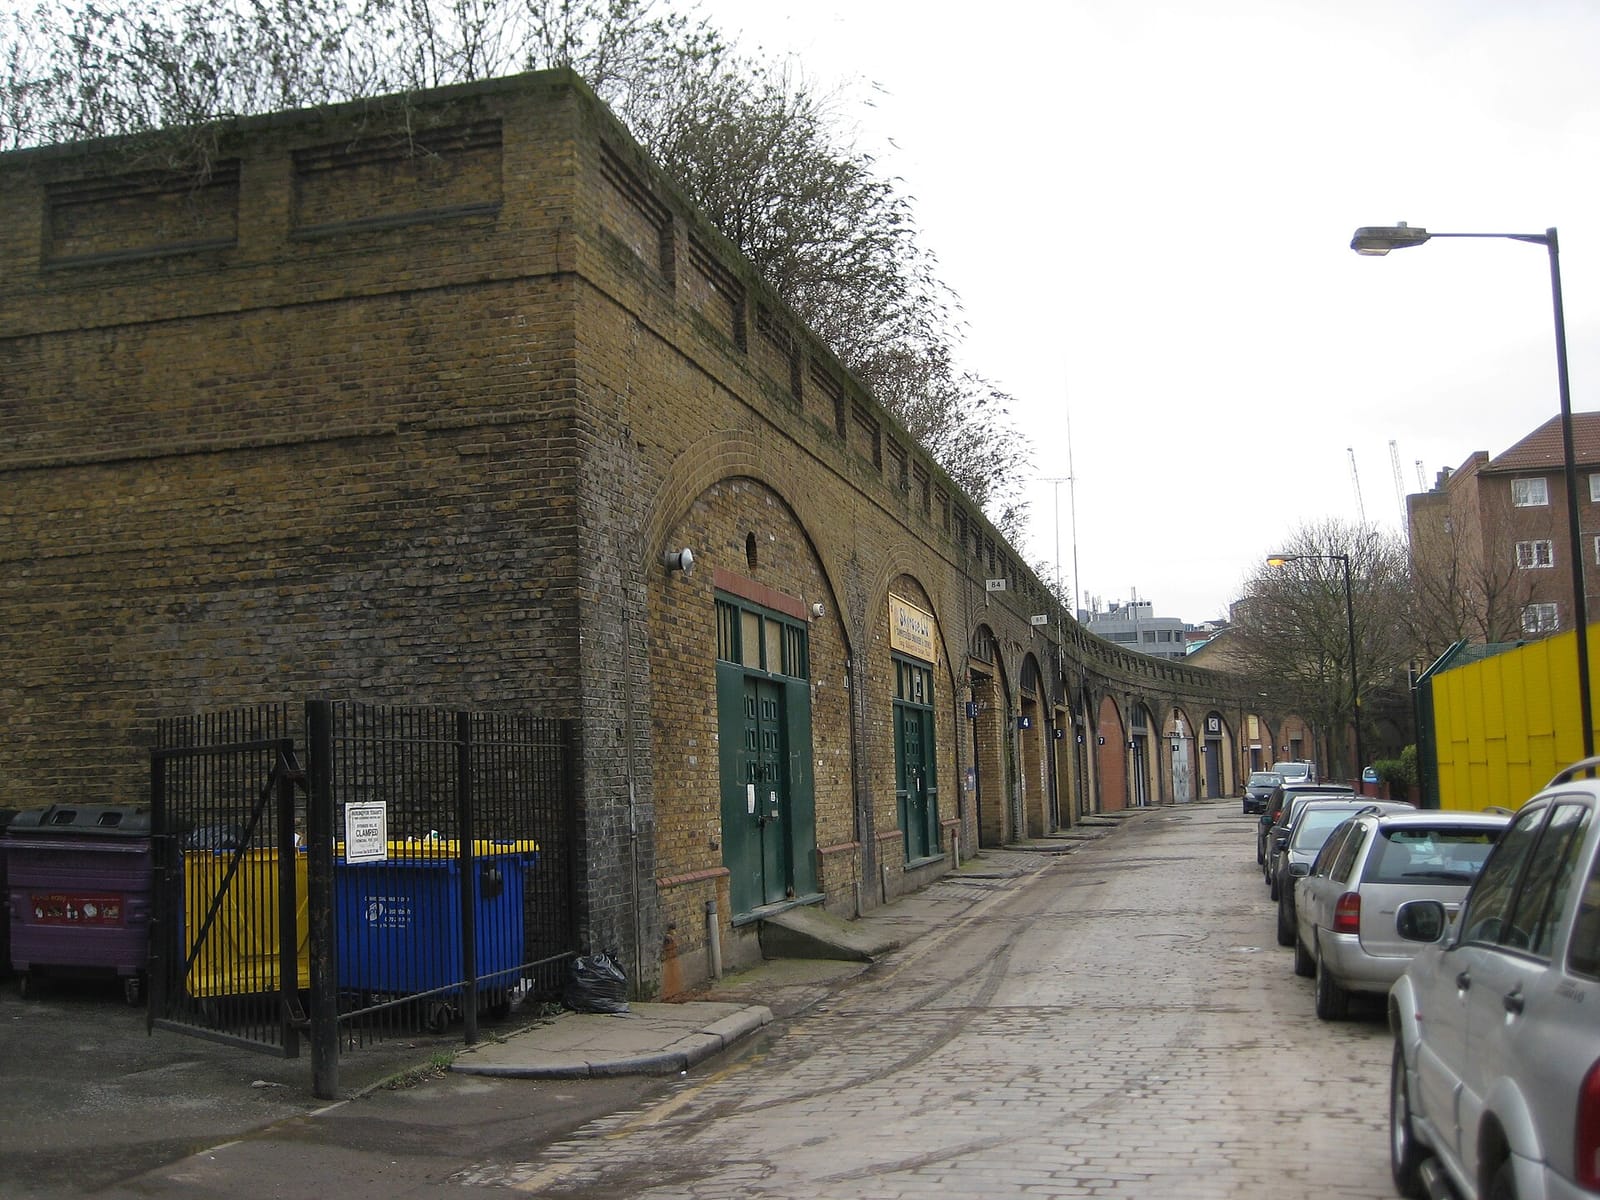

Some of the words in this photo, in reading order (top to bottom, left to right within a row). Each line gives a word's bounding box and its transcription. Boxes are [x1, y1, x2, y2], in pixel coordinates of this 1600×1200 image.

[1023, 718, 1029, 727] 4
[1056, 730, 1062, 738] 5
[355, 829, 379, 838] CLAMPED
